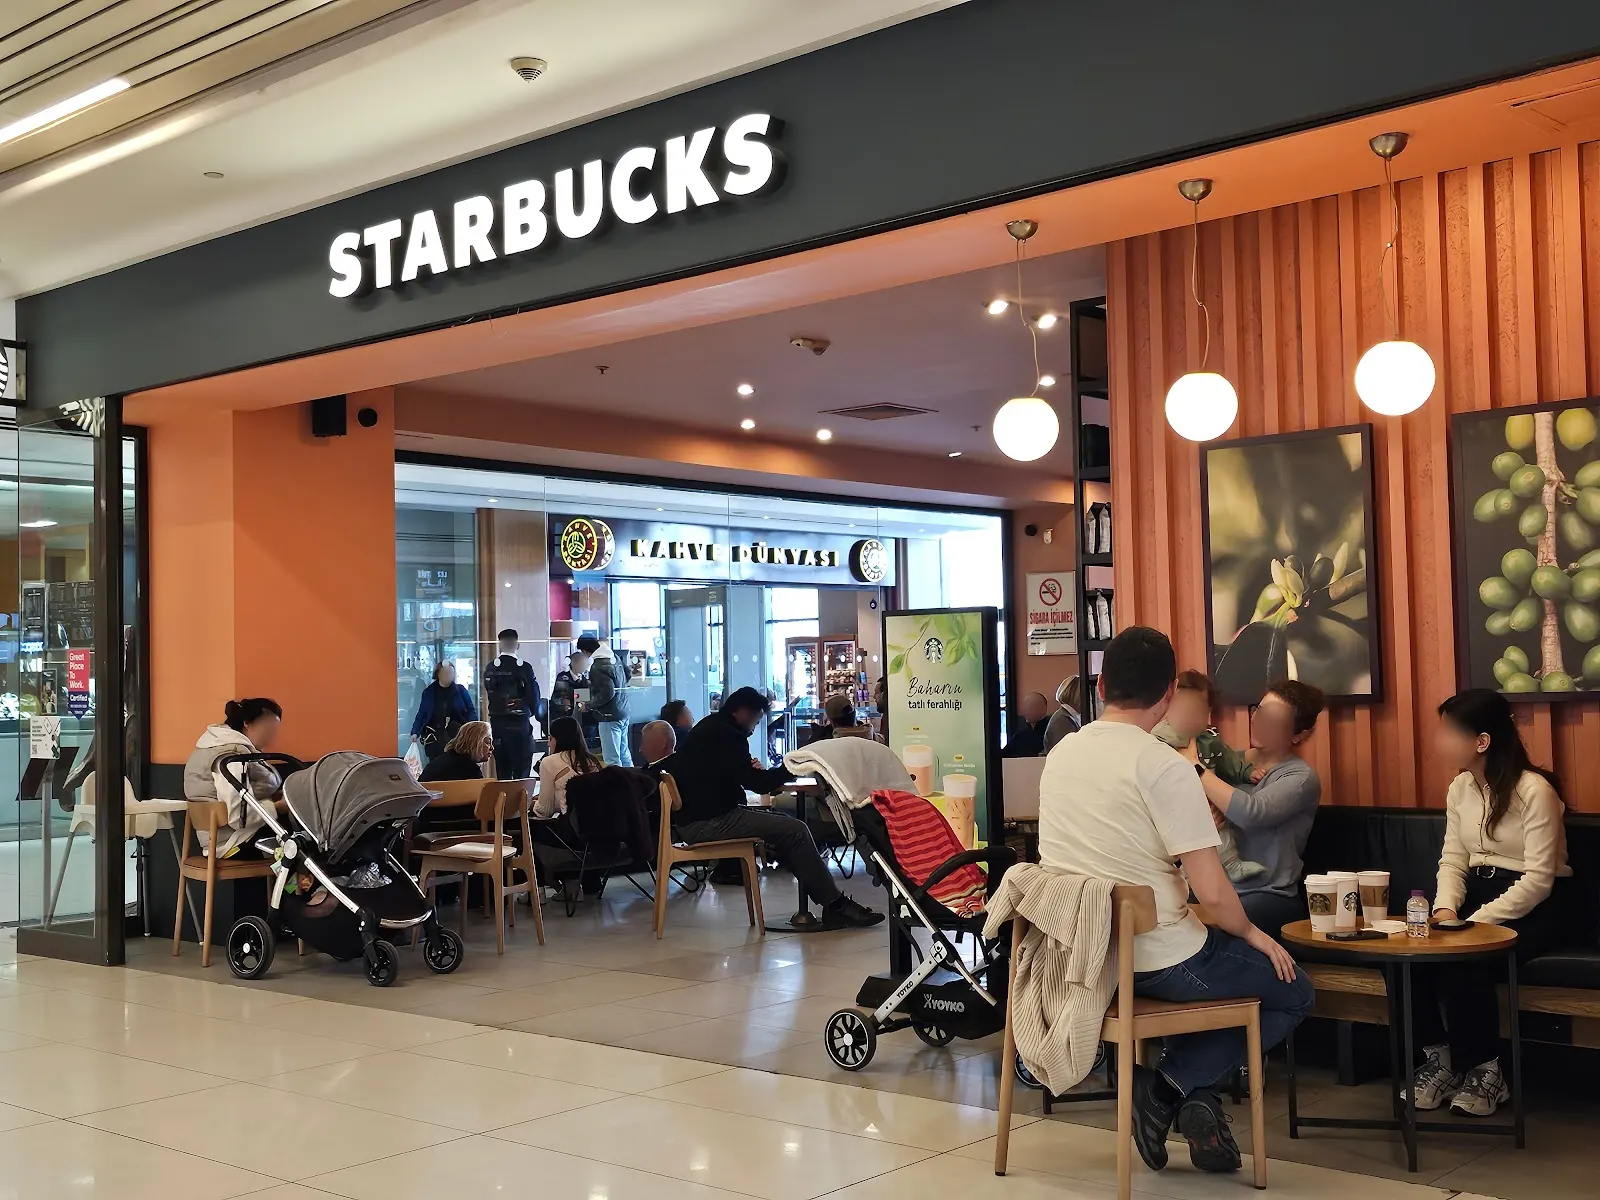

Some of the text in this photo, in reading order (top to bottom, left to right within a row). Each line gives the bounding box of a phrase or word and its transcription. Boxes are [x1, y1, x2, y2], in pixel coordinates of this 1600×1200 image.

[328, 113, 774, 299] STARBUCKS
[631, 539, 722, 561] KAHVE
[732, 542, 840, 567] DÜNYASI
[69, 653, 85, 661] Great
[69, 662, 85, 670] Place
[69, 671, 76, 679] To
[69, 680, 85, 689] Work.
[906, 676, 963, 698] Baharın
[69, 694, 88, 702] Certified
[908, 699, 962, 711] tatlı ferahlığı
[896, 980, 914, 999] YOYKO
[931, 998, 965, 1013] YOYKO
